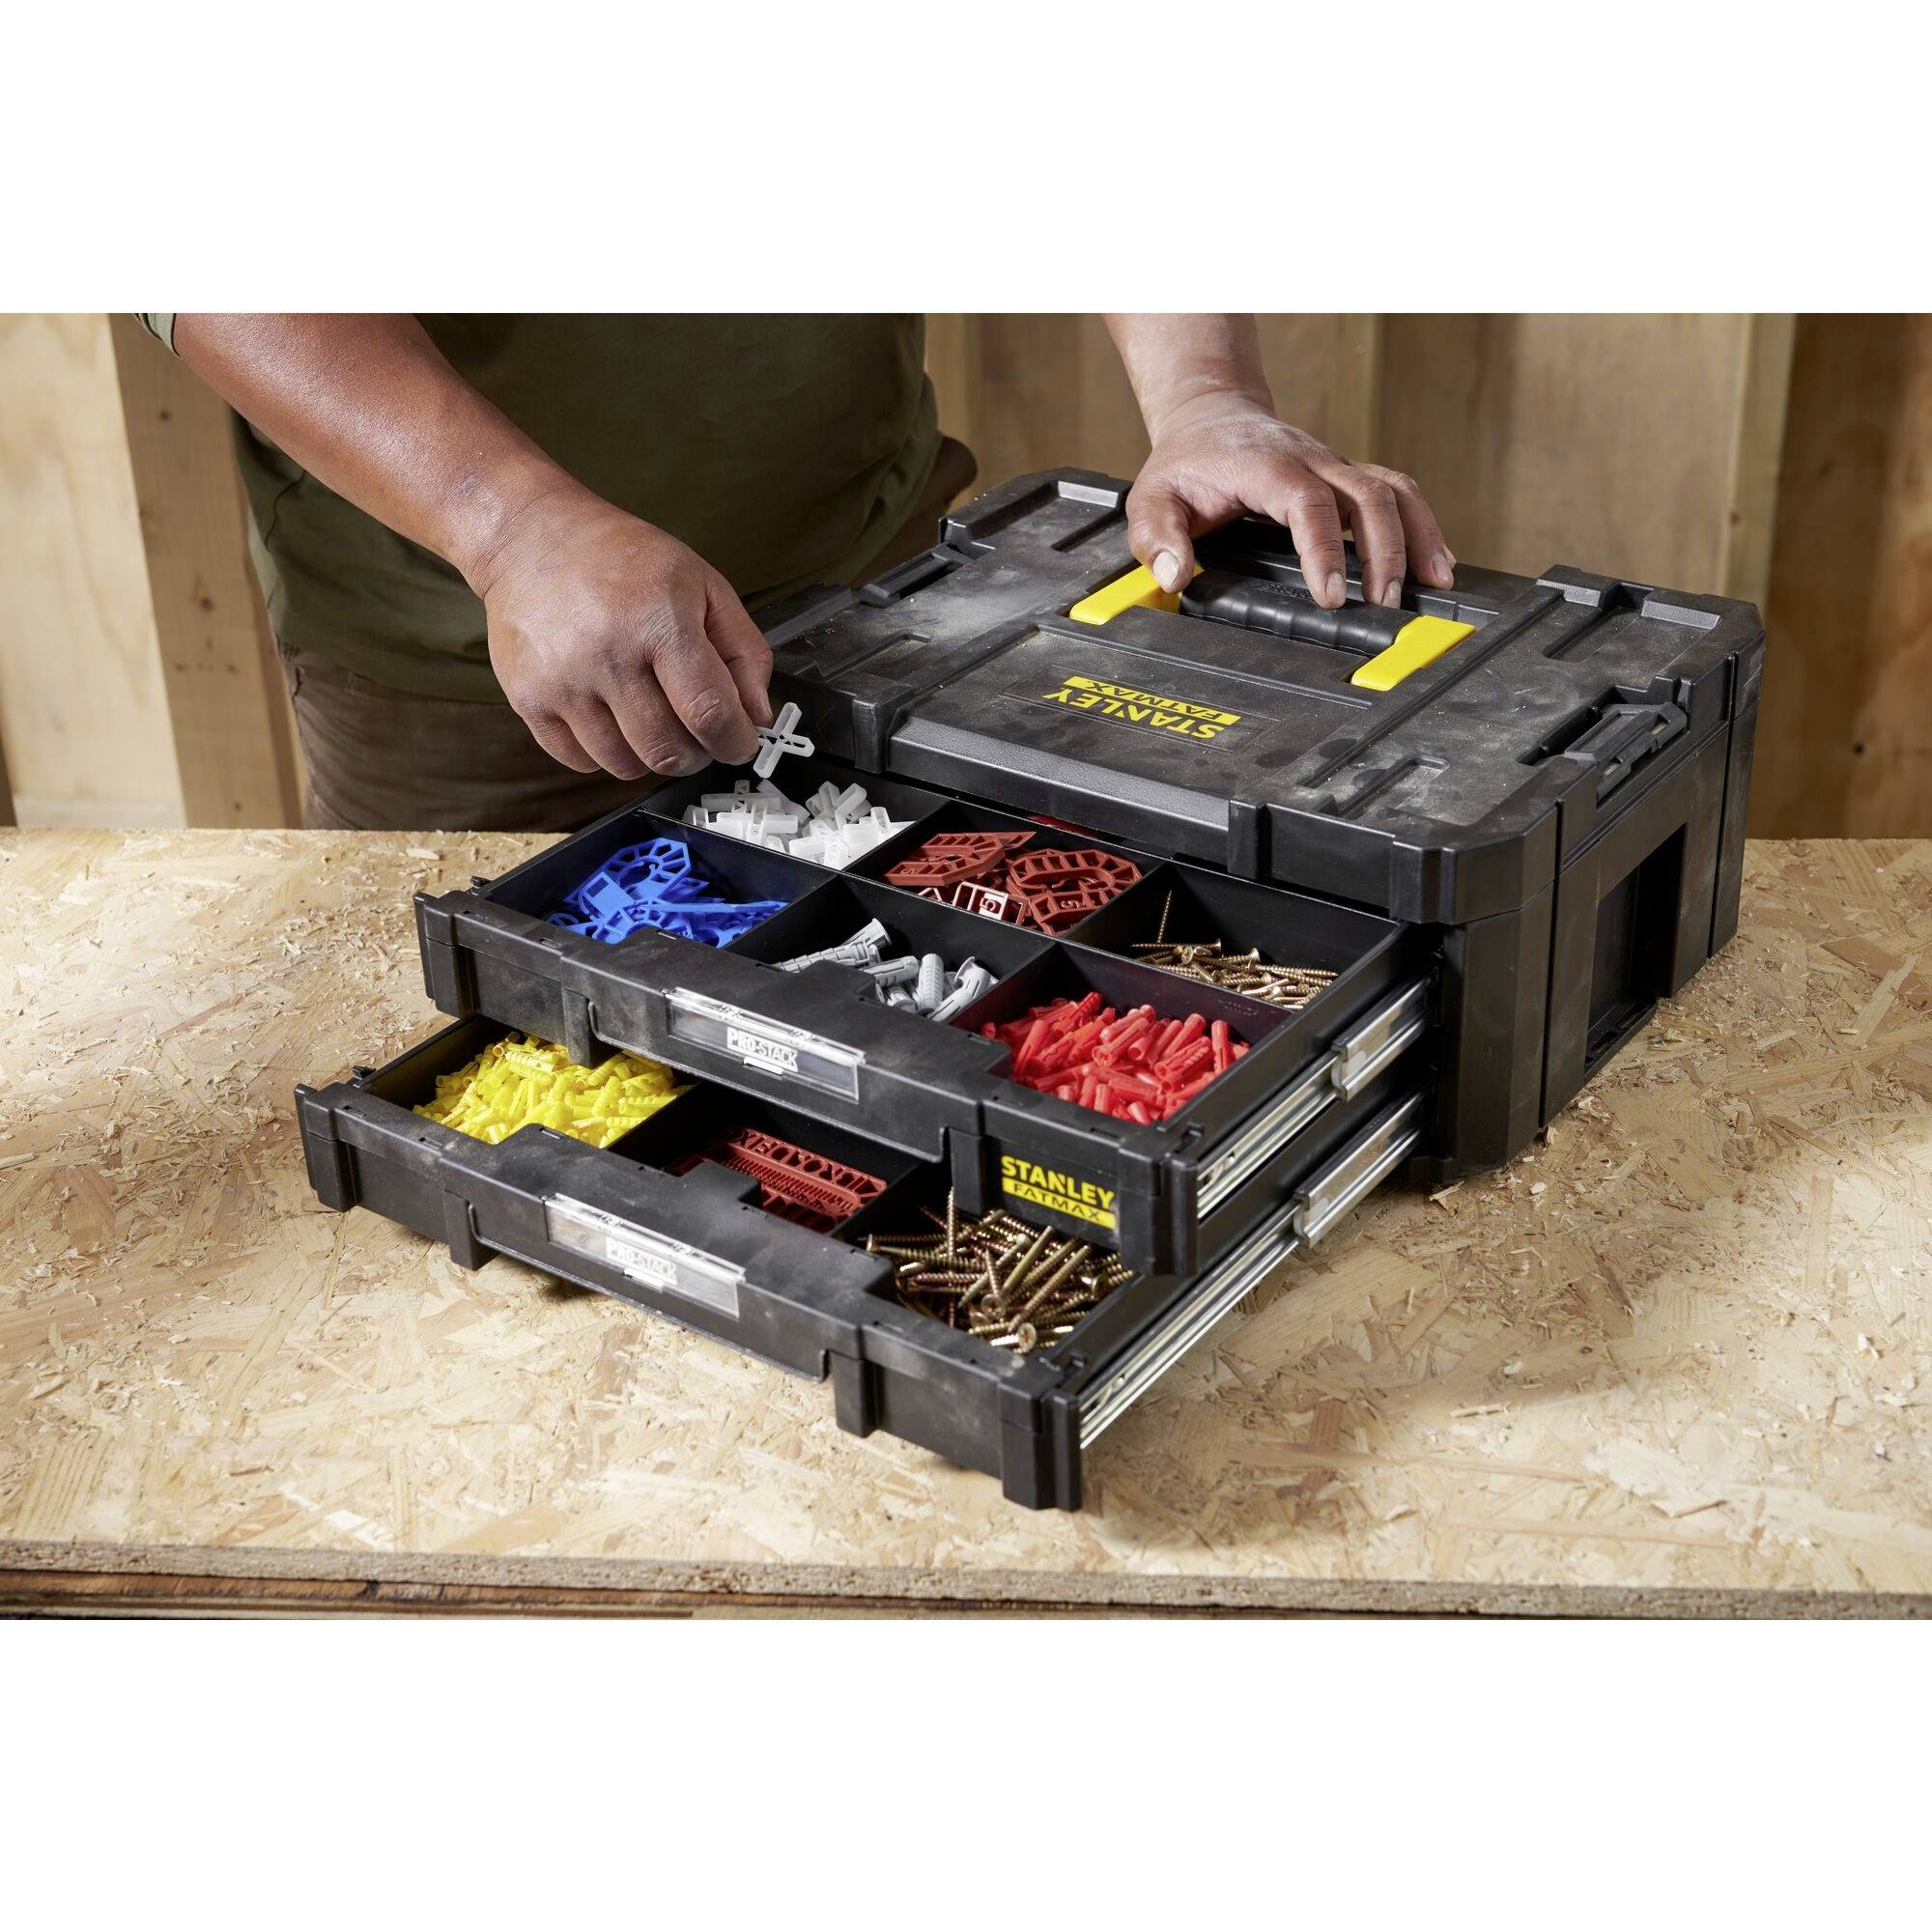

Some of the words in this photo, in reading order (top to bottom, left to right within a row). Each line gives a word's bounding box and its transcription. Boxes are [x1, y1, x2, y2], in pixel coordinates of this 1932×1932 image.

[1042, 689, 1224, 739] STANLEY
[1088, 681, 1222, 720] FATMAX
[726, 1026, 799, 1069] PRO-STACK
[1001, 1155, 1115, 1209] STANLEY
[1013, 1181, 1100, 1223] FATMAX
